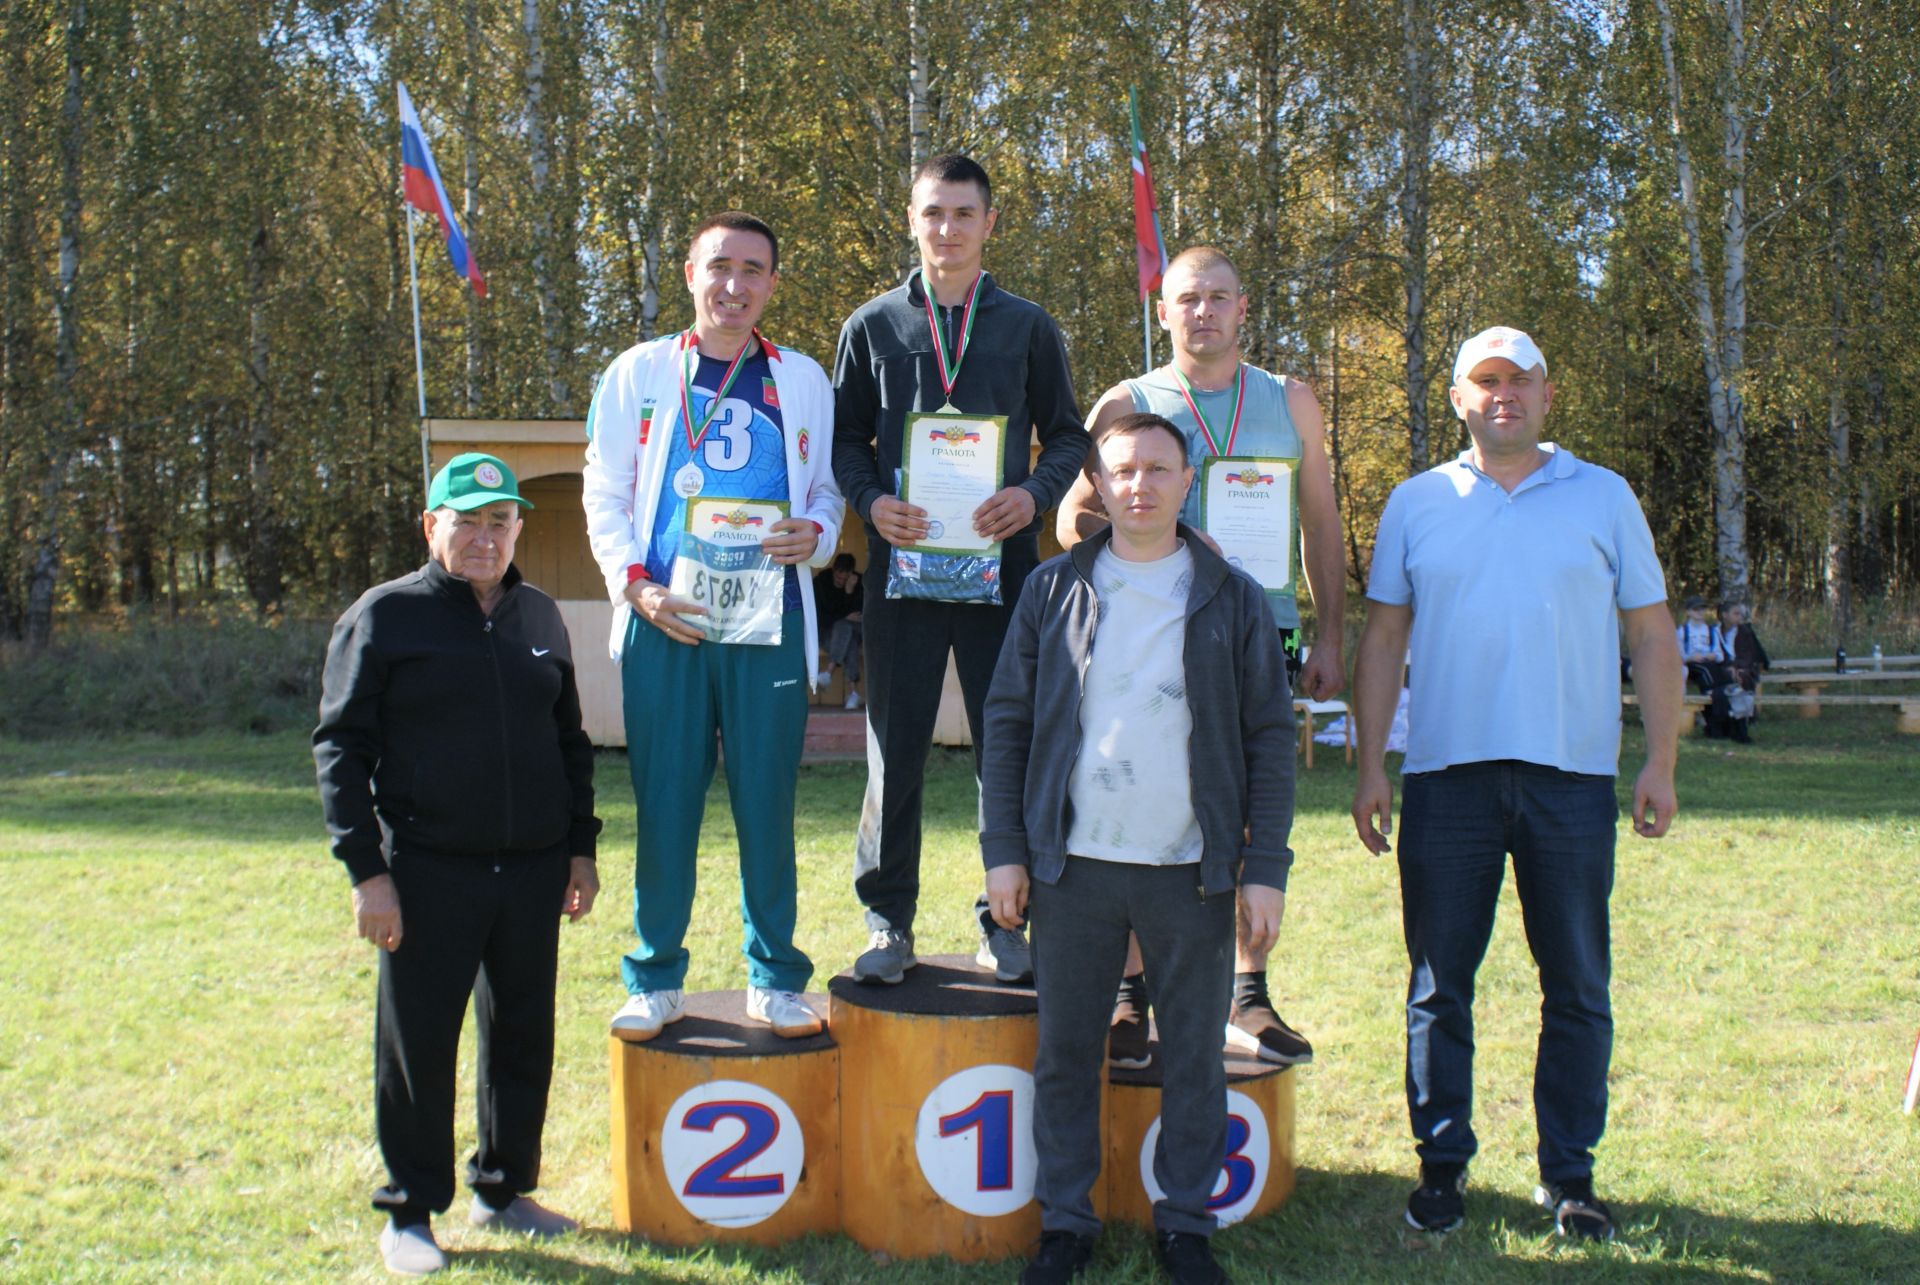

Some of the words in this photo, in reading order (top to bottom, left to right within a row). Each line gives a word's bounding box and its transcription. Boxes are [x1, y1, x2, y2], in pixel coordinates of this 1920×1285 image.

[703, 397, 753, 472] 3
[931, 448, 976, 457] ГРАМОТА
[1228, 490, 1270, 499] ГРАМОТА
[713, 531, 758, 542] ГРАМОТА
[681, 1100, 785, 1198] 2
[939, 1090, 1013, 1192] 1
